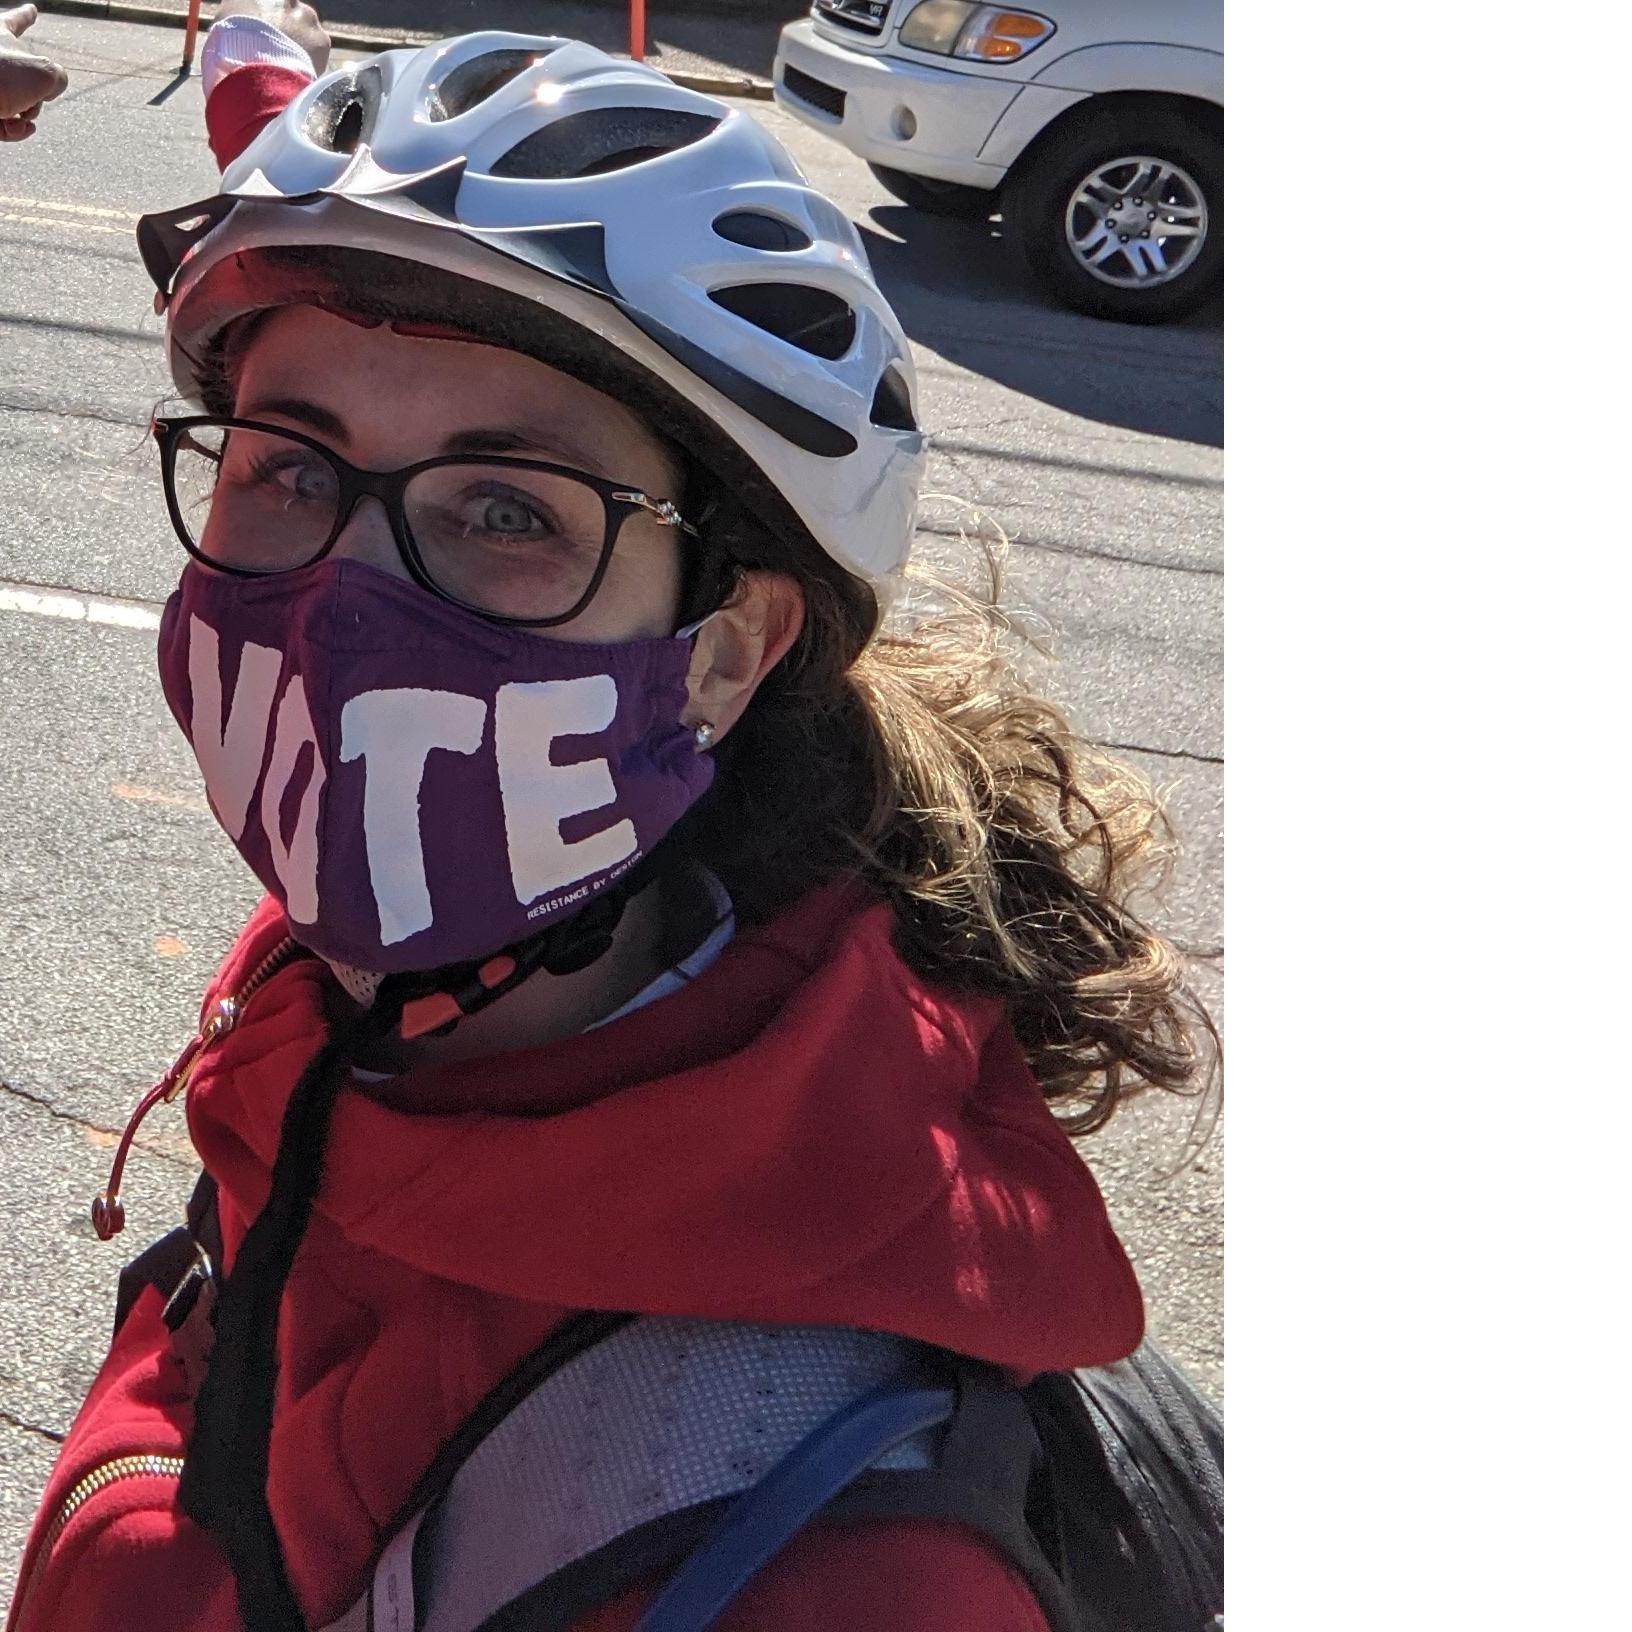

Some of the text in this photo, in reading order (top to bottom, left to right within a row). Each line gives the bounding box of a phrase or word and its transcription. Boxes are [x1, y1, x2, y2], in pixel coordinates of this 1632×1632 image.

[188, 611, 638, 946] VOTE
[527, 885, 590, 921] RESISTANCE
[593, 878, 607, 891] BY
